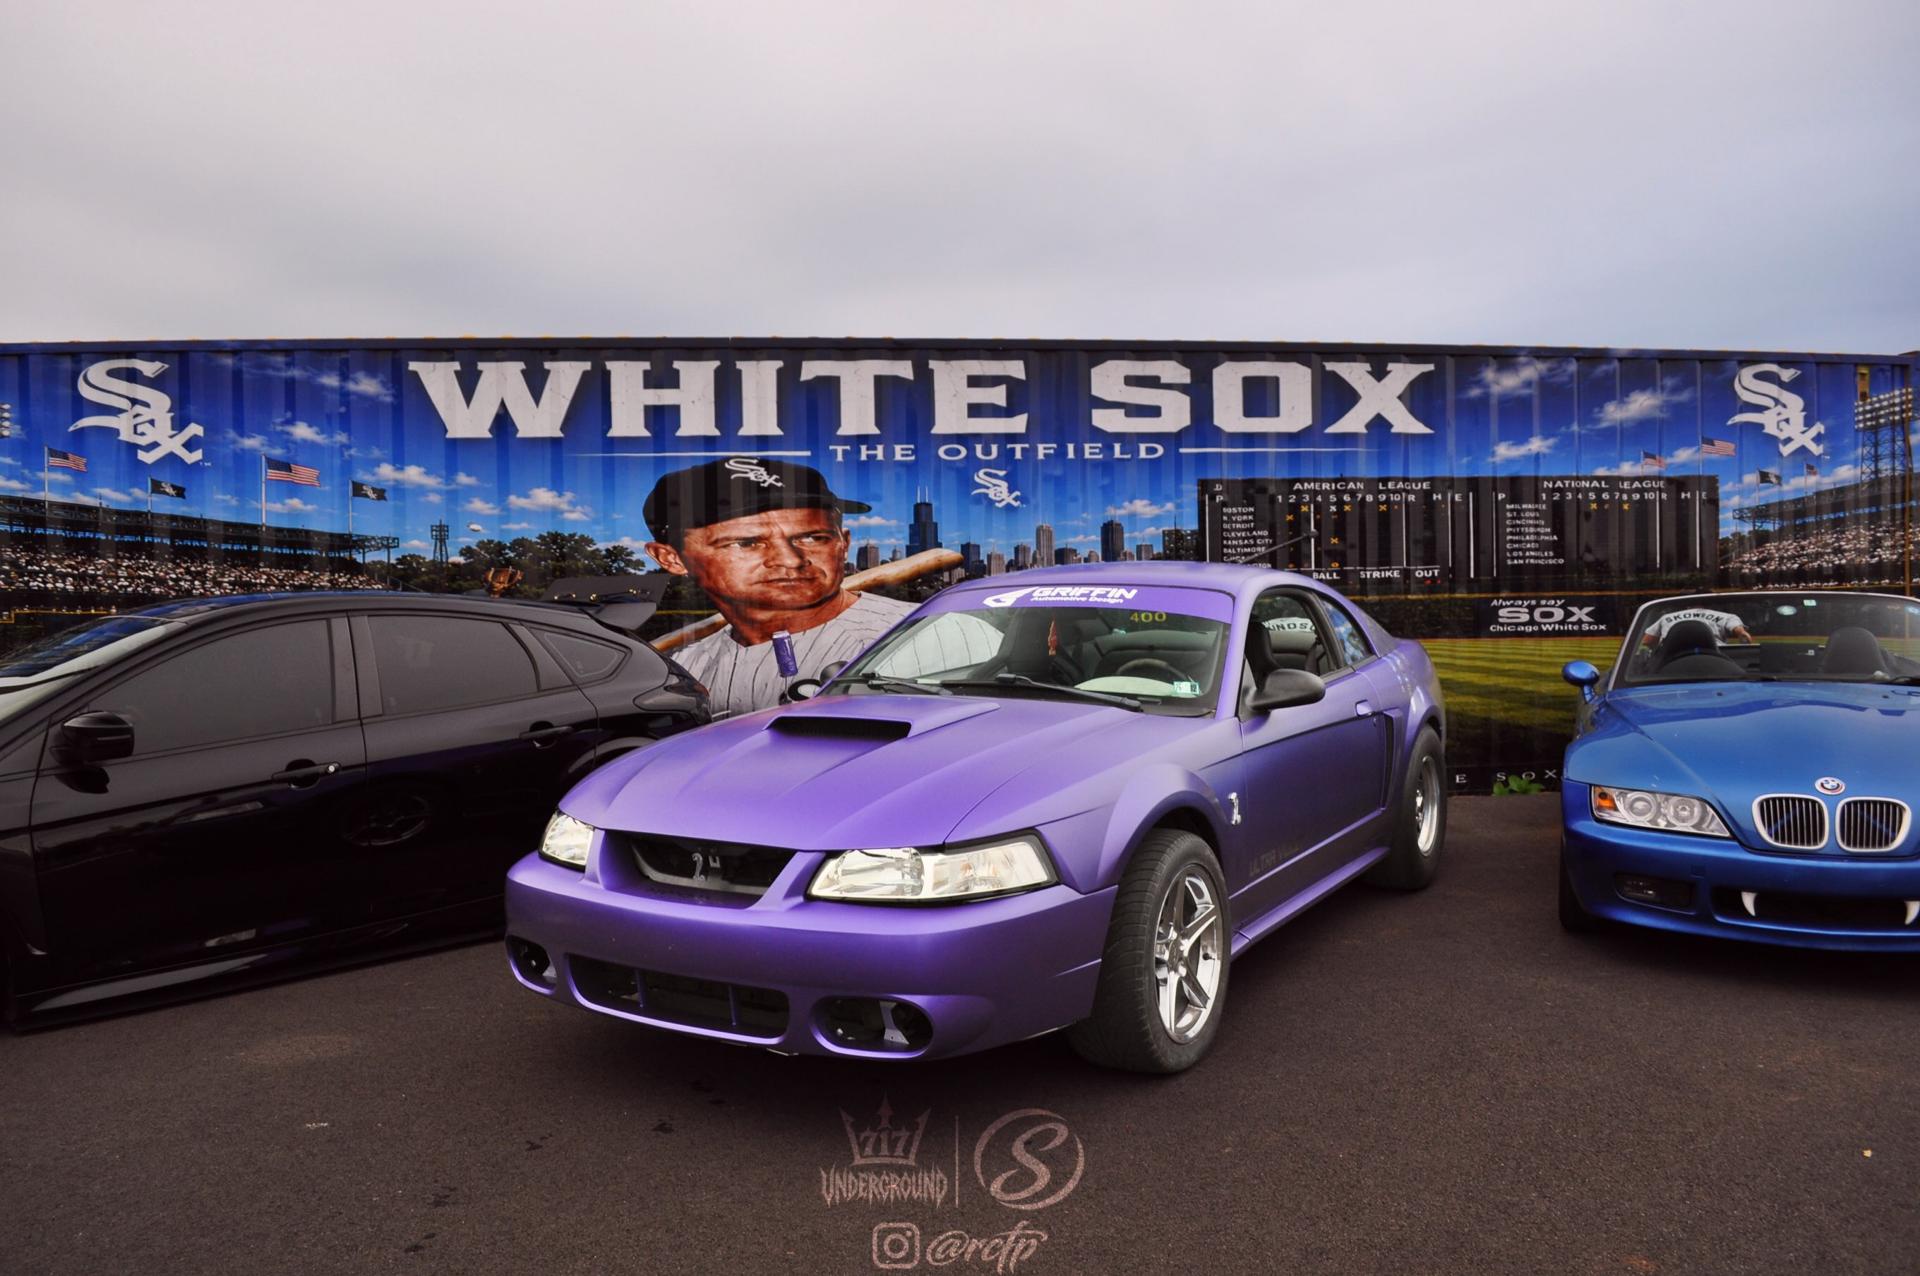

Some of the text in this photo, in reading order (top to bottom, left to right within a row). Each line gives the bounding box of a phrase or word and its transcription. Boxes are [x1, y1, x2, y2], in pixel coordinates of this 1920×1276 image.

[407, 358, 1435, 439] WHITE SOX
[829, 442, 1164, 462] THE OUTFIELD
[1292, 481, 1431, 491] AMERICAN LEAGUE
[1543, 480, 1665, 490] NATIONAL LEAGUE
[1288, 494, 1297, 503] 2
[1302, 493, 1310, 503] 3
[1316, 494, 1322, 502] 4
[1329, 494, 1337, 503] 5
[1342, 493, 1351, 502] 6
[1356, 492, 1363, 502] 7
[1365, 494, 1374, 503] 8
[1377, 493, 1387, 502] 9
[1552, 492, 1561, 501] 2
[1565, 491, 1573, 500] 3
[1588, 491, 1596, 500] 5
[1601, 491, 1610, 500] 6
[1621, 493, 1628, 501] 8
[1631, 492, 1641, 501] 9
[1222, 530, 1269, 538] CLEVELAND
[1312, 569, 1440, 580] BALL STRIKE OUT
[1032, 587, 1138, 599] GRIFFIN
[1490, 599, 1536, 607] Always
[1130, 611, 1168, 623] 400
[1498, 607, 1595, 623] SOX
[1582, 623, 1607, 631] Sox
[1497, 770, 1557, 781] SOX
